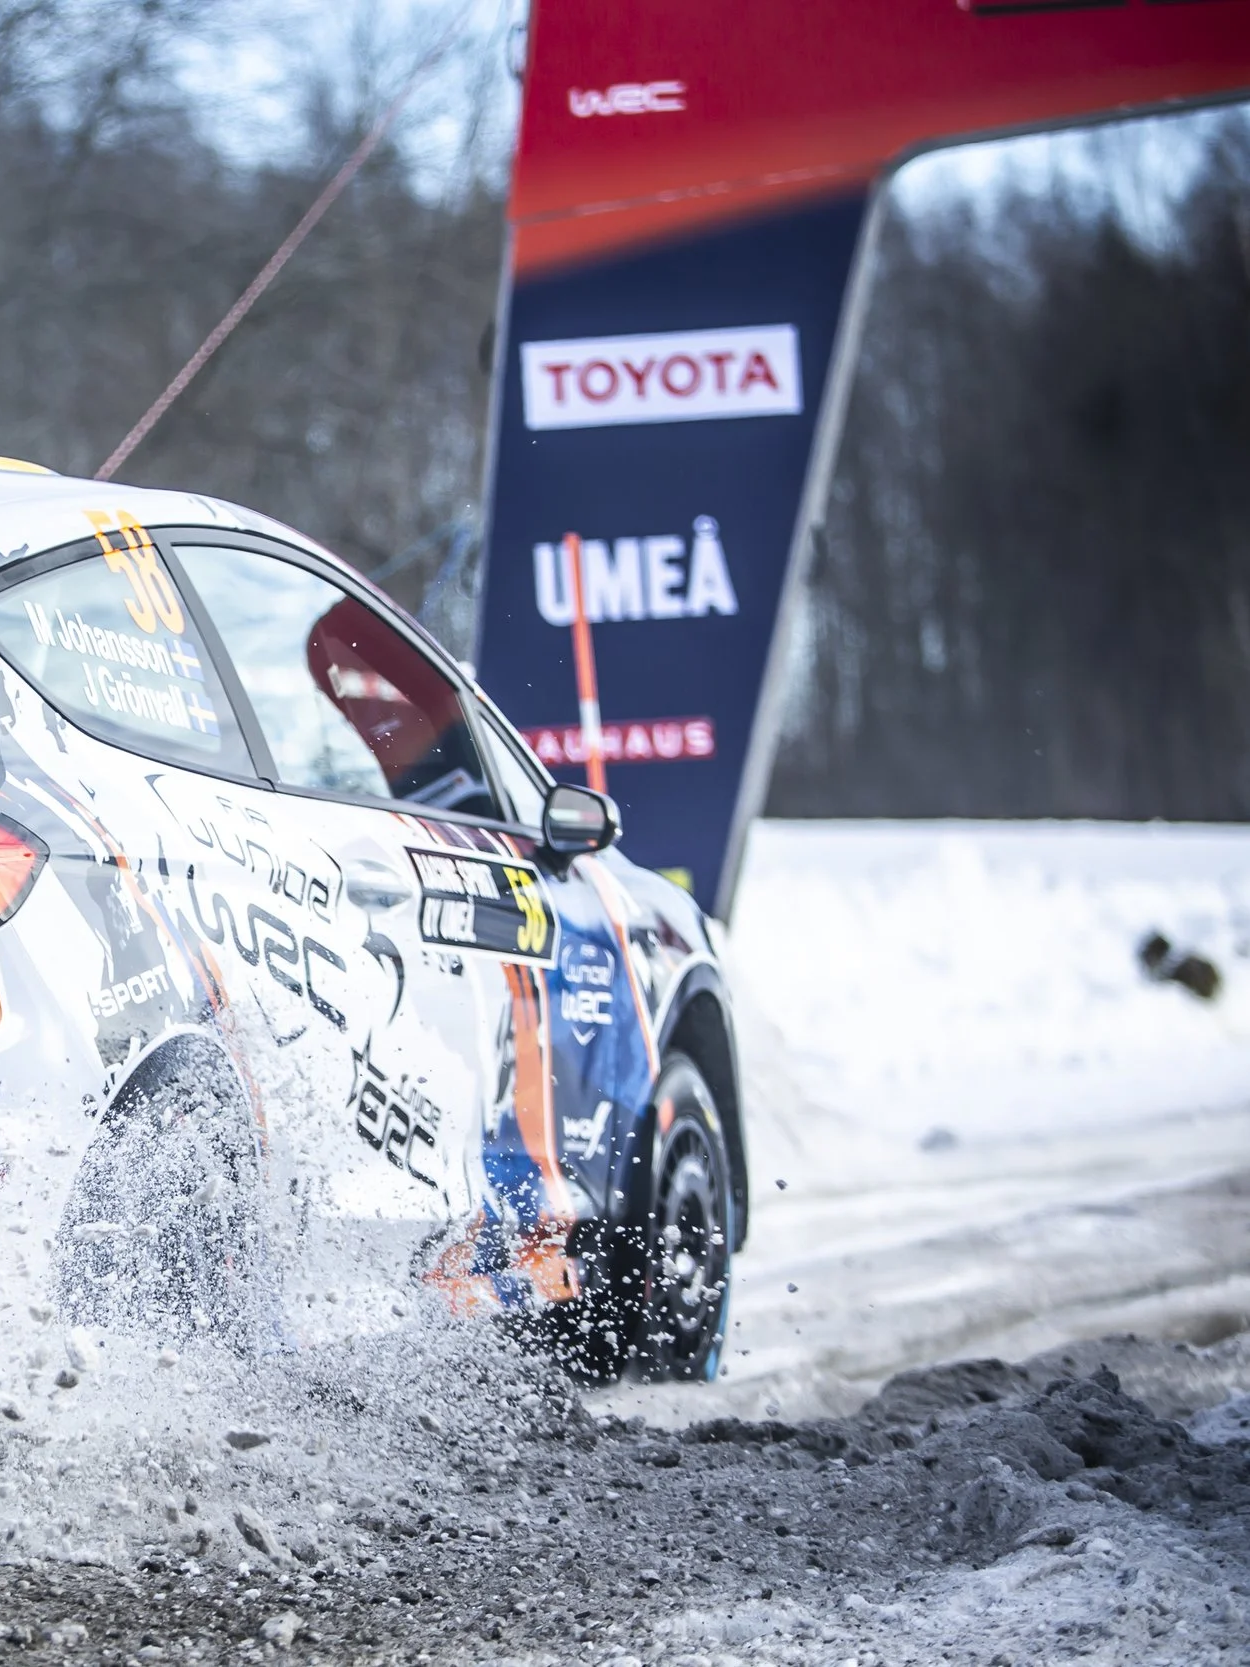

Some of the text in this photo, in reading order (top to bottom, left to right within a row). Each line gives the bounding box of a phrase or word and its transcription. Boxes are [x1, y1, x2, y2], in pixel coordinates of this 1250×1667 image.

[569, 80, 686, 117] WRC
[543, 353, 779, 404] TOYOTA
[83, 510, 185, 634] 58
[533, 514, 739, 627] UMEÅ
[24, 600, 176, 678] M Johansson
[82, 662, 192, 730] J Grönvall
[502, 866, 548, 954] 58
